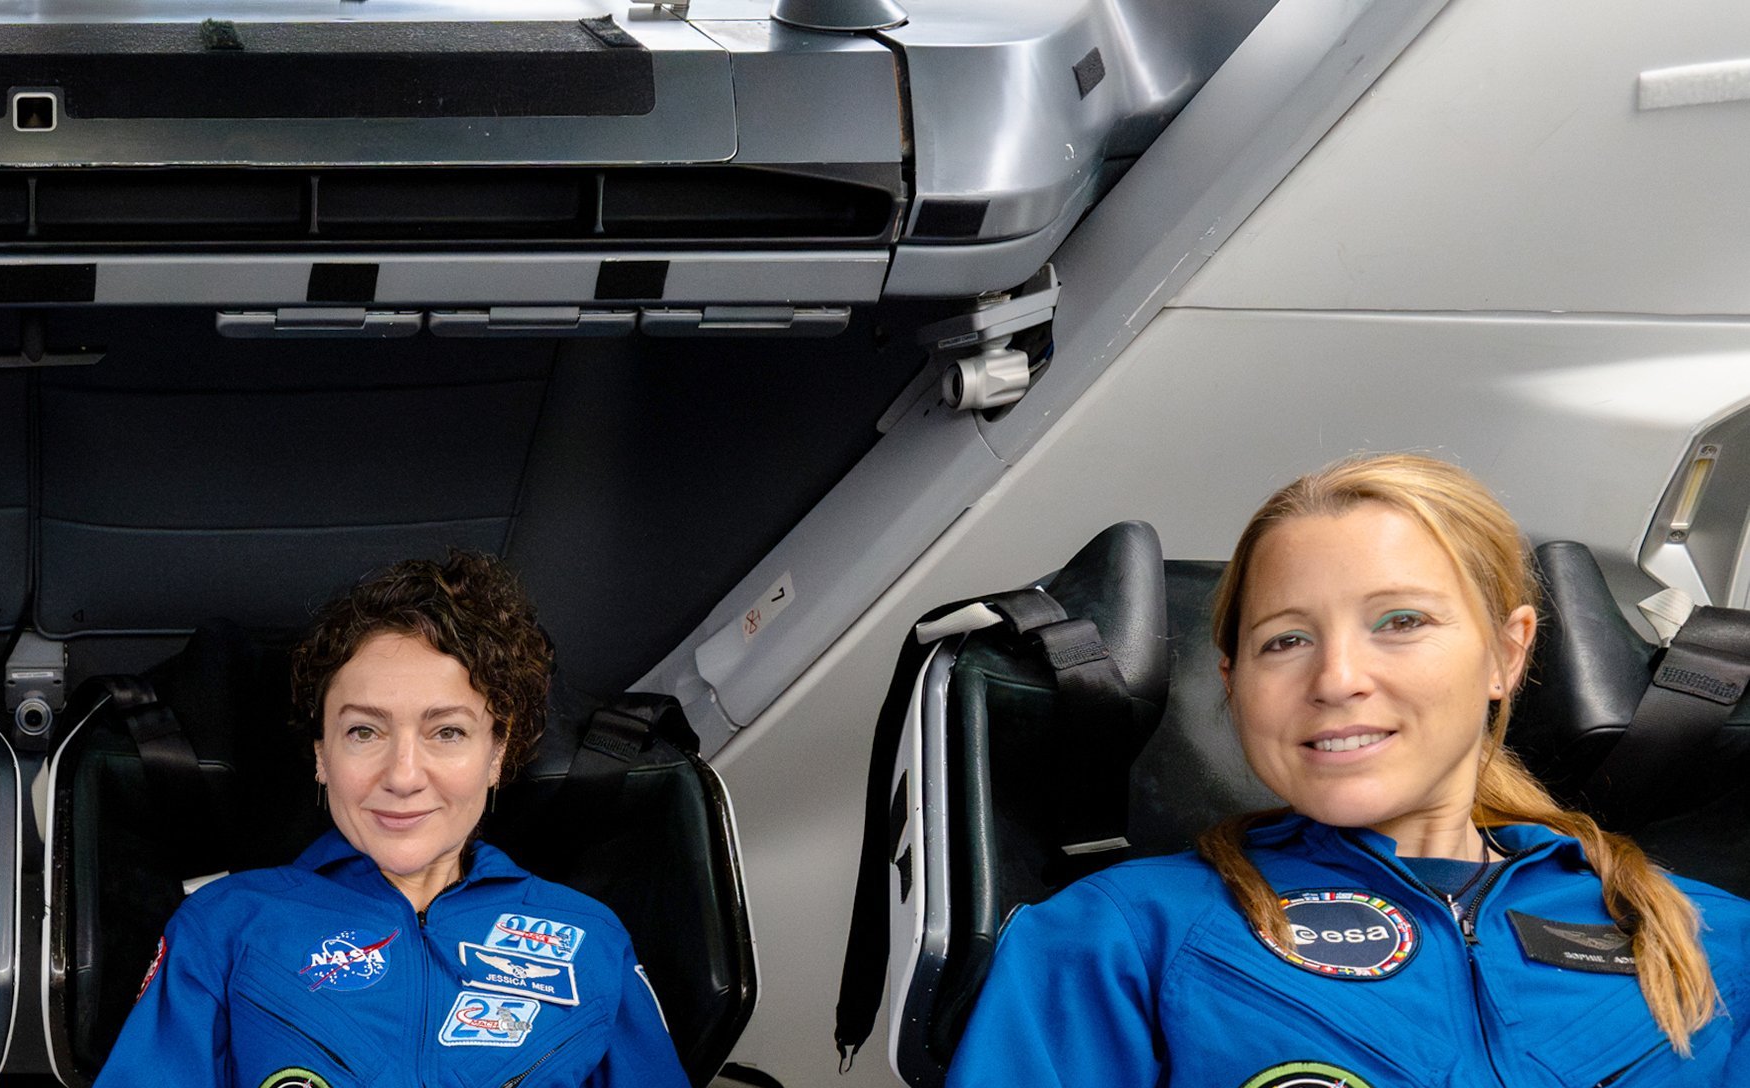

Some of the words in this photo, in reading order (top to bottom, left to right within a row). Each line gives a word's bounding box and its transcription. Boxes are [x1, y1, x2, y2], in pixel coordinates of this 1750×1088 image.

[1321, 925, 1390, 943] esa
[311, 949, 386, 967] NASA
[485, 974, 527, 987] JESSICA
[531, 982, 555, 994] MEIR
[451, 998, 525, 1038] 25
